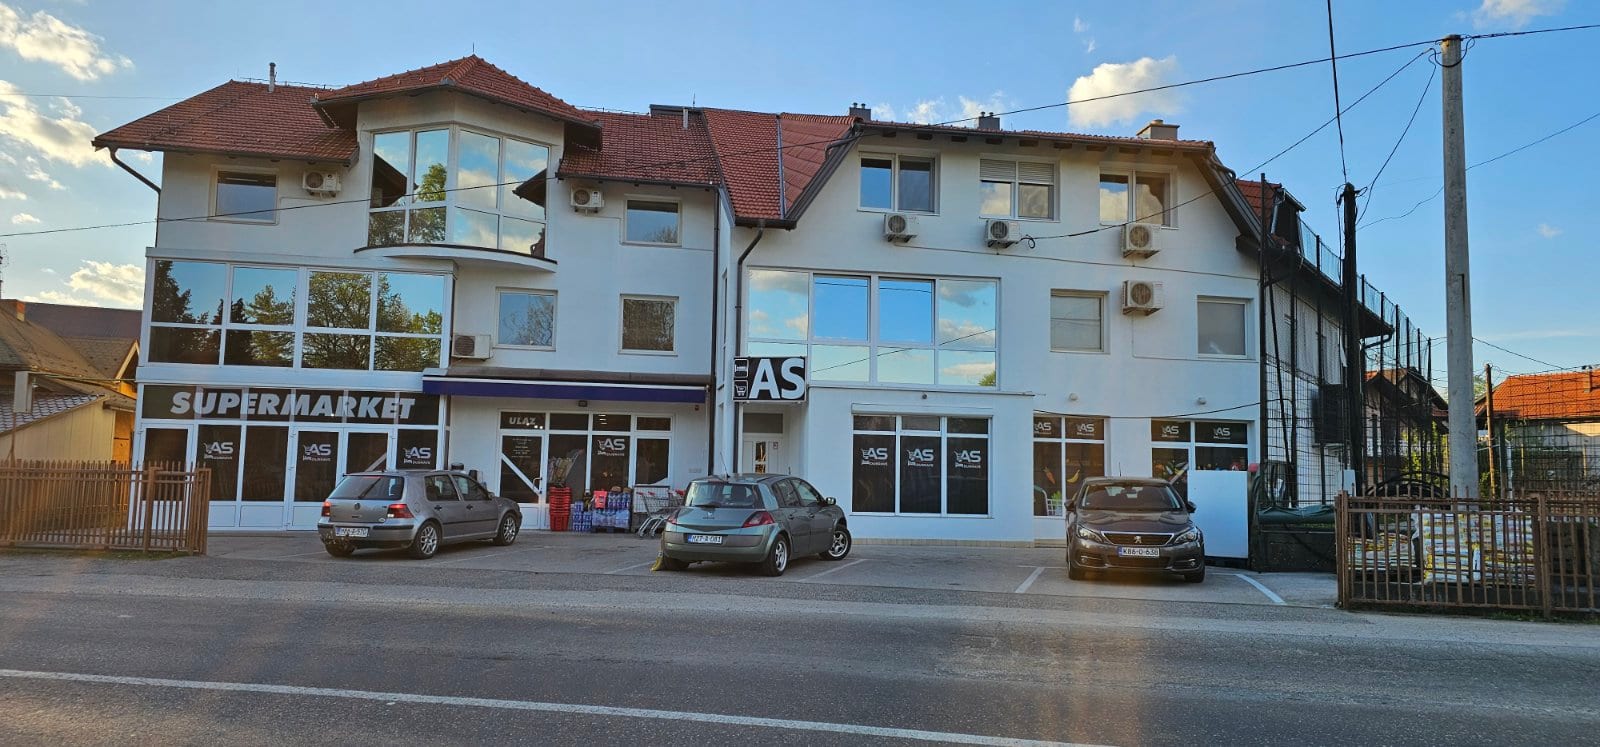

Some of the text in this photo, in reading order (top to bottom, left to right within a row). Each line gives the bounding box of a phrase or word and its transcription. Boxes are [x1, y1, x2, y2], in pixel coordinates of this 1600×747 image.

[748, 357, 805, 400] AS
[170, 391, 416, 419] SUPERMARKET
[509, 416, 536, 425] ULAZ
[1037, 421, 1052, 431] AS
[1080, 423, 1095, 433] AS
[1165, 425, 1180, 434] AS
[1216, 427, 1231, 436] AS
[210, 441, 234, 455] AS
[309, 443, 332, 456] AS
[604, 438, 625, 451] AS
[410, 446, 431, 459] AS
[868, 447, 888, 460] AS
[914, 448, 934, 461] AS
[960, 449, 981, 463] AS
